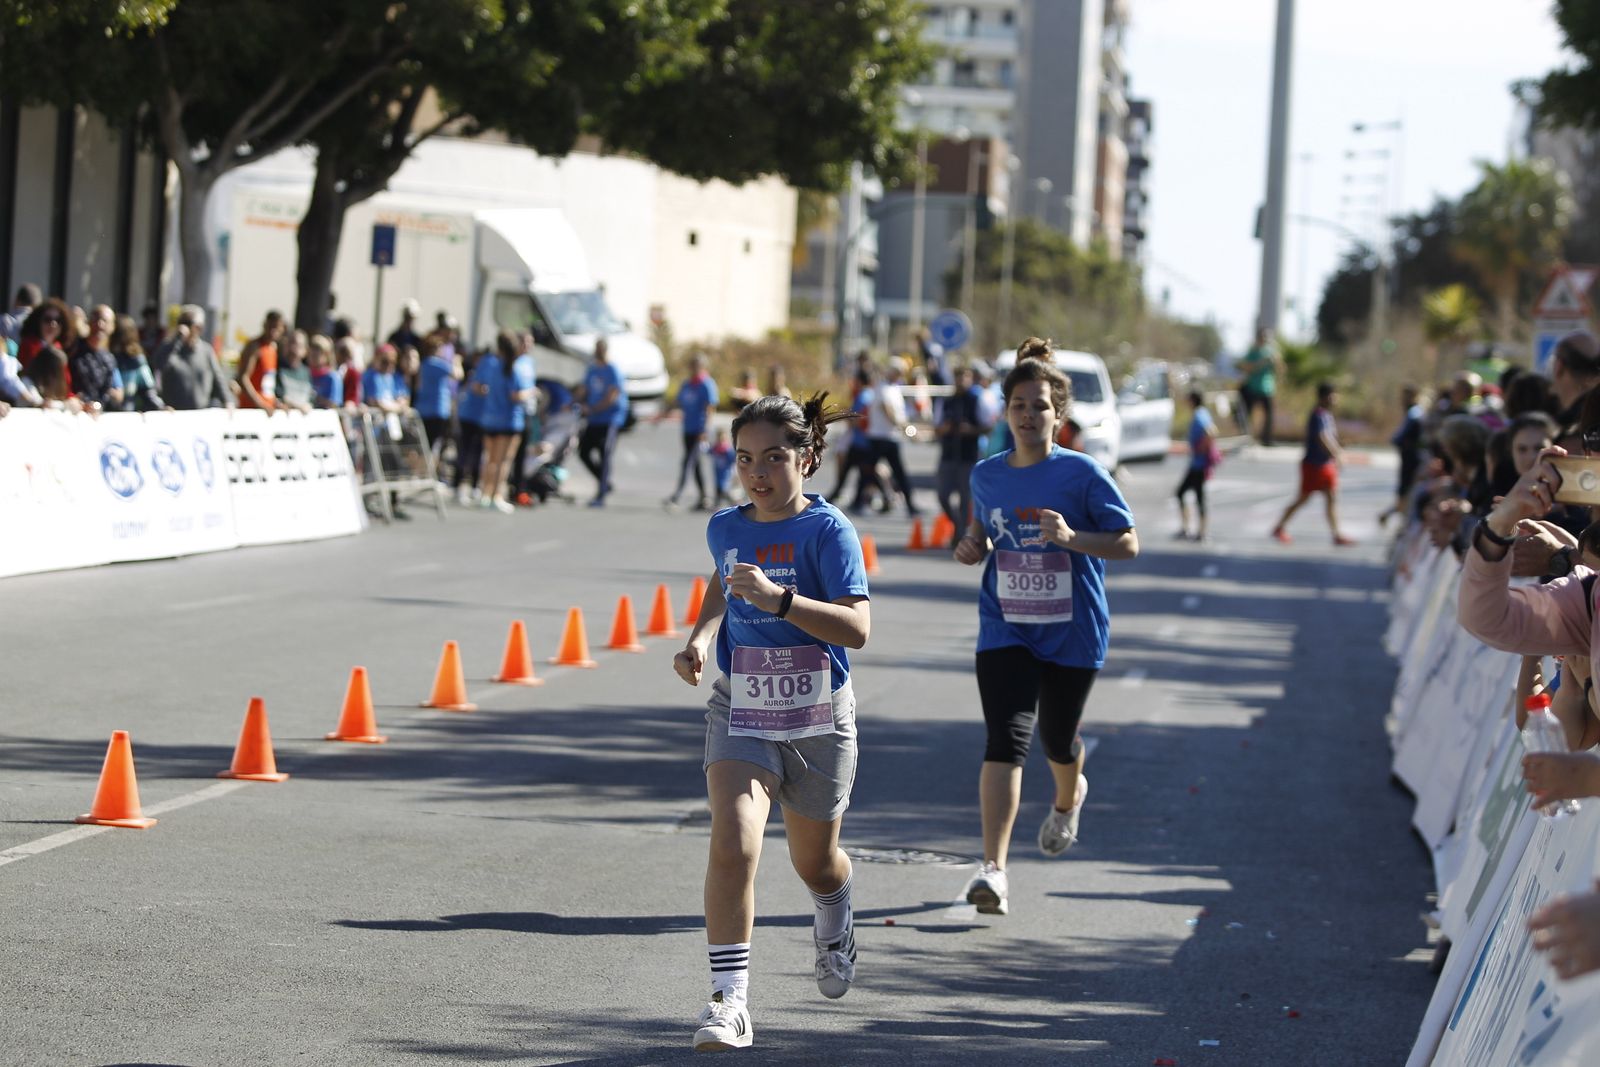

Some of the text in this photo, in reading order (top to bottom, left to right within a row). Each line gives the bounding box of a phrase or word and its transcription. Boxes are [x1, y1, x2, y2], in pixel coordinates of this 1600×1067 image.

[755, 543, 795, 564] VIII
[763, 568, 797, 577] RRERA
[1007, 573, 1058, 591] 3098
[774, 649, 792, 657] VIII
[746, 673, 813, 698] 3108
[763, 699, 795, 707] AURORA
